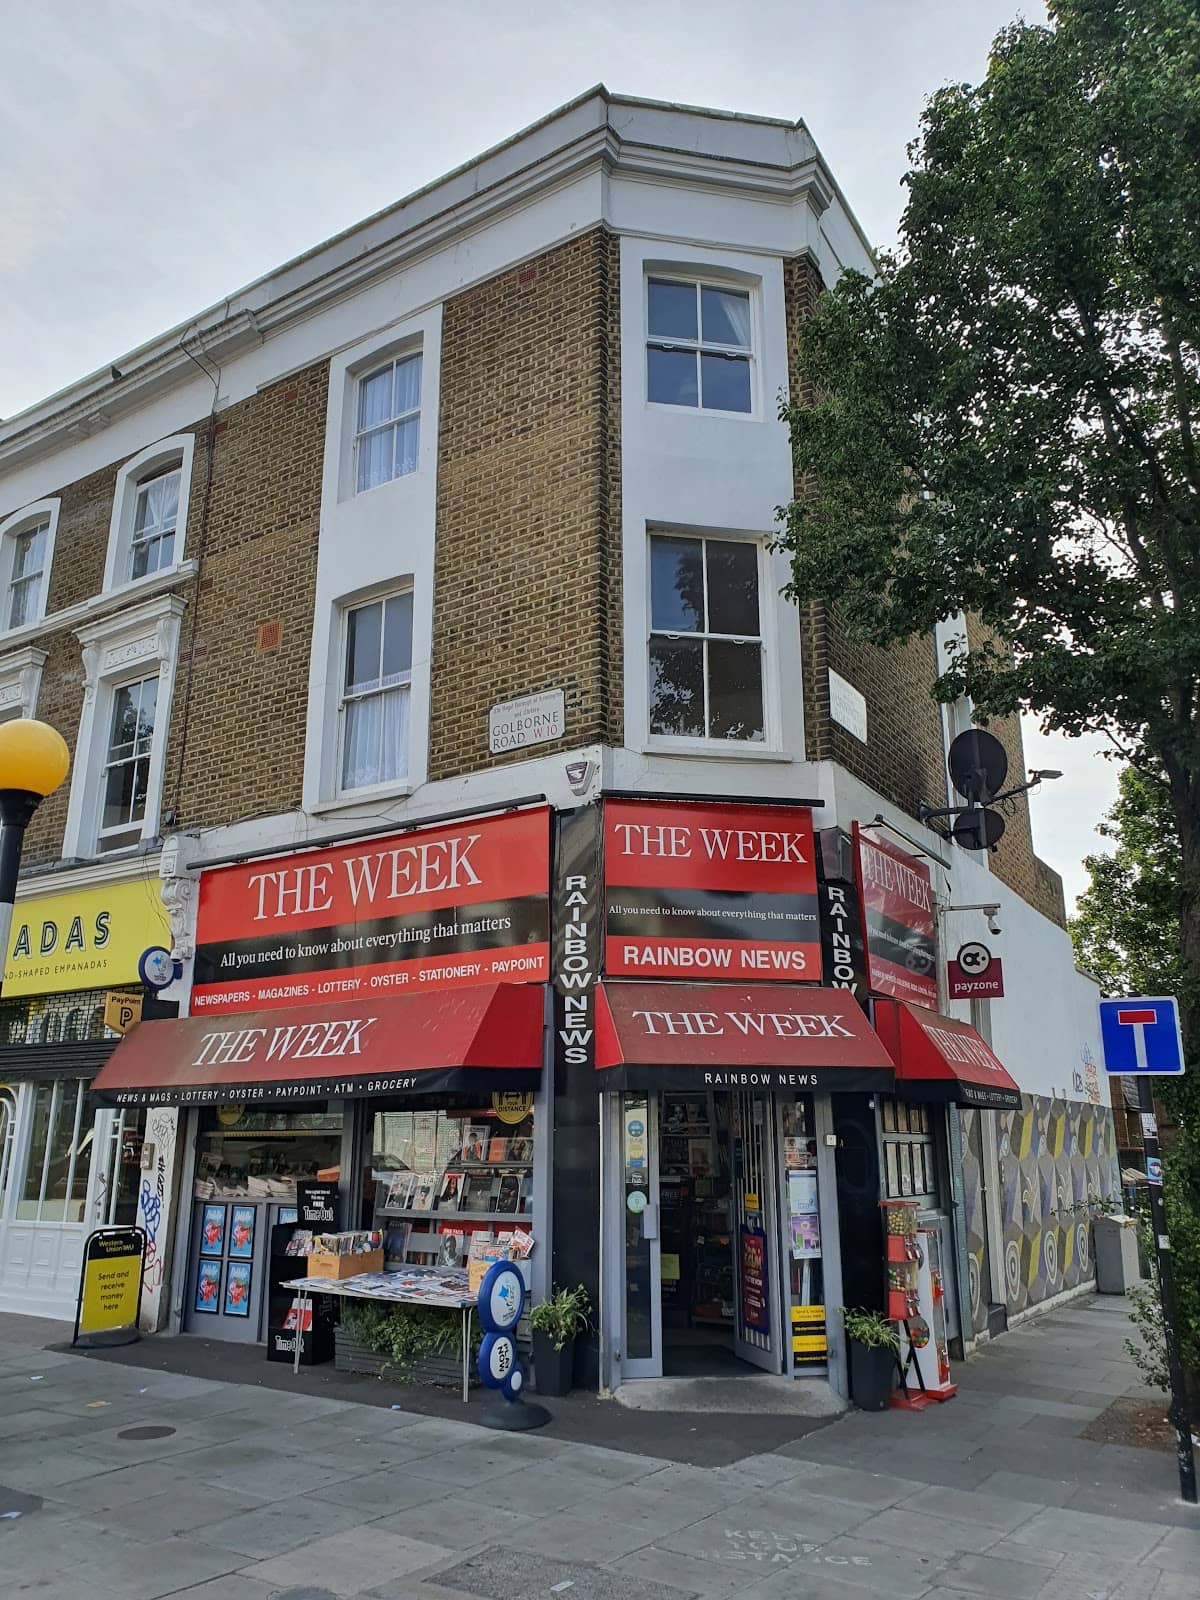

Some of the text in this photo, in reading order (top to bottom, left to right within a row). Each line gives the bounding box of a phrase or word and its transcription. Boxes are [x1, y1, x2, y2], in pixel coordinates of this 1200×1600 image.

[492, 711, 560, 737] GOLBORNE
[493, 724, 558, 750] ROAD W 10
[614, 824, 808, 864] THE WEEK
[248, 834, 483, 922] THE WEEK
[893, 862, 931, 913] WEEK
[609, 905, 817, 921] All you need to know about everything that matters
[220, 916, 512, 969] All you need to know about everything that matters
[54, 959, 108, 974] EMPANADAS
[559, 875, 593, 1065] RAINBOW NEWS
[623, 945, 806, 970] RAINBOW NEWS
[194, 955, 545, 1007] NEWSPAPERS MAGAZINES LOTTERY OYSTER STATIONERY PAYPOINT
[954, 981, 999, 994] payzone
[631, 1009, 857, 1038] THE WEEK
[191, 1017, 379, 1066] THE WEEK
[116, 1077, 417, 1103] NEWS & MAGS LOTTERY OYSTER PAYPOINT ATM GROCERY
[704, 1072, 819, 1086] RAINBOW NEWS
[99, 1240, 124, 1248] Western
[106, 1245, 123, 1253] Union
[97, 1269, 130, 1281] Send and
[100, 1281, 126, 1291] receive
[100, 1292, 124, 1301] money
[103, 1303, 119, 1311] here
[292, 1337, 305, 1353] Ot
[497, 1345, 505, 1372] NOW
[702, 1550, 873, 1566] STACE
